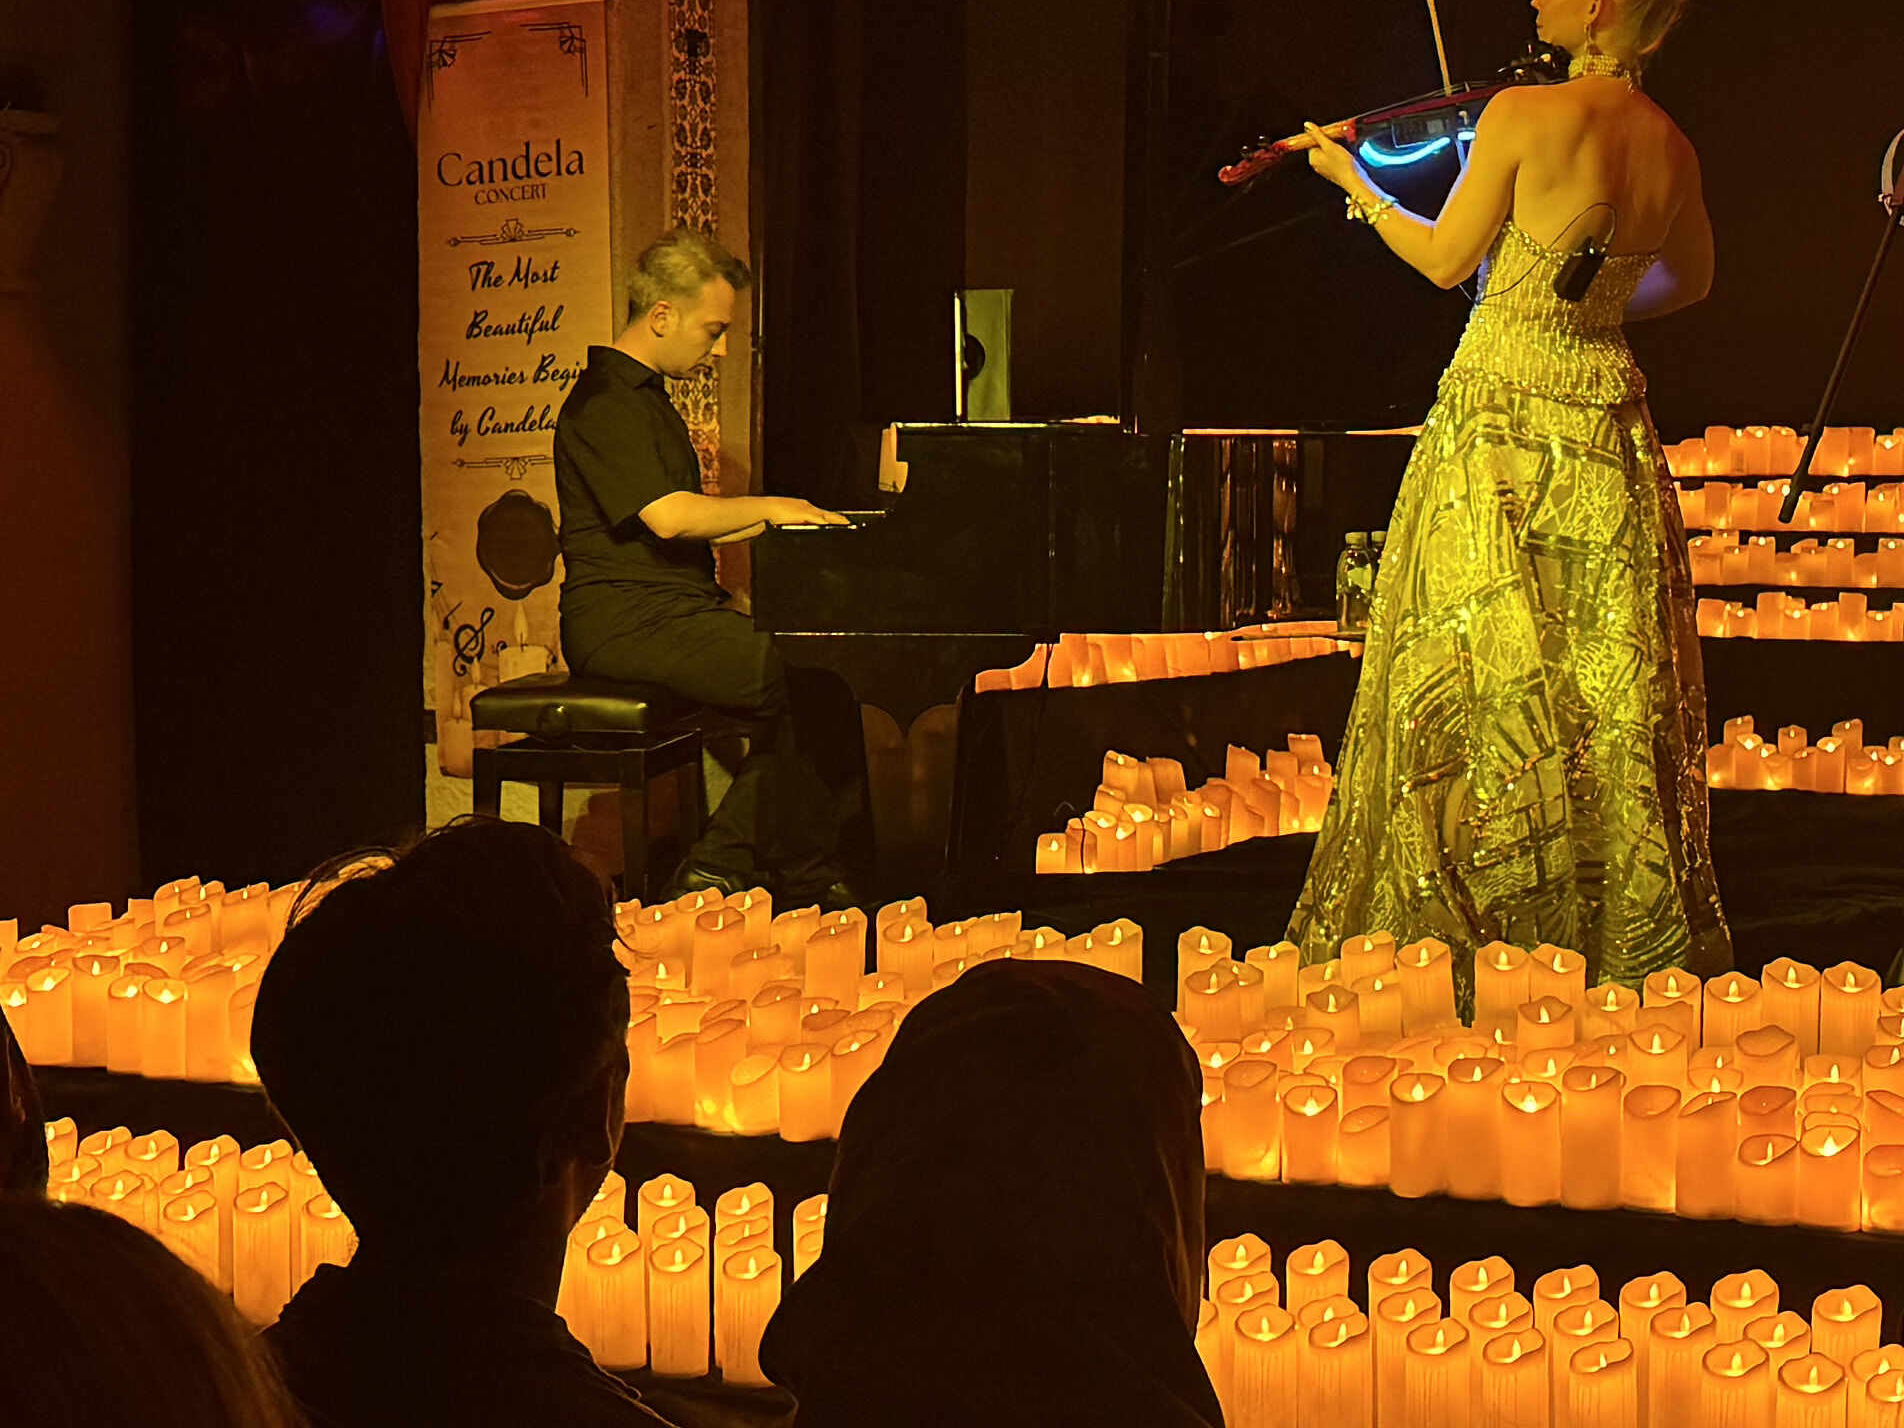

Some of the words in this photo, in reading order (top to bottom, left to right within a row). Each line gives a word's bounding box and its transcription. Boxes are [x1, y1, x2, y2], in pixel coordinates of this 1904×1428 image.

[437, 138, 585, 187] Candela
[474, 183, 548, 205] CONCERT
[469, 261, 504, 291] The
[508, 255, 560, 289] Most
[466, 305, 564, 345] Beautiful
[439, 359, 527, 392] Memories
[533, 353, 584, 392] Begi
[450, 409, 470, 447] by
